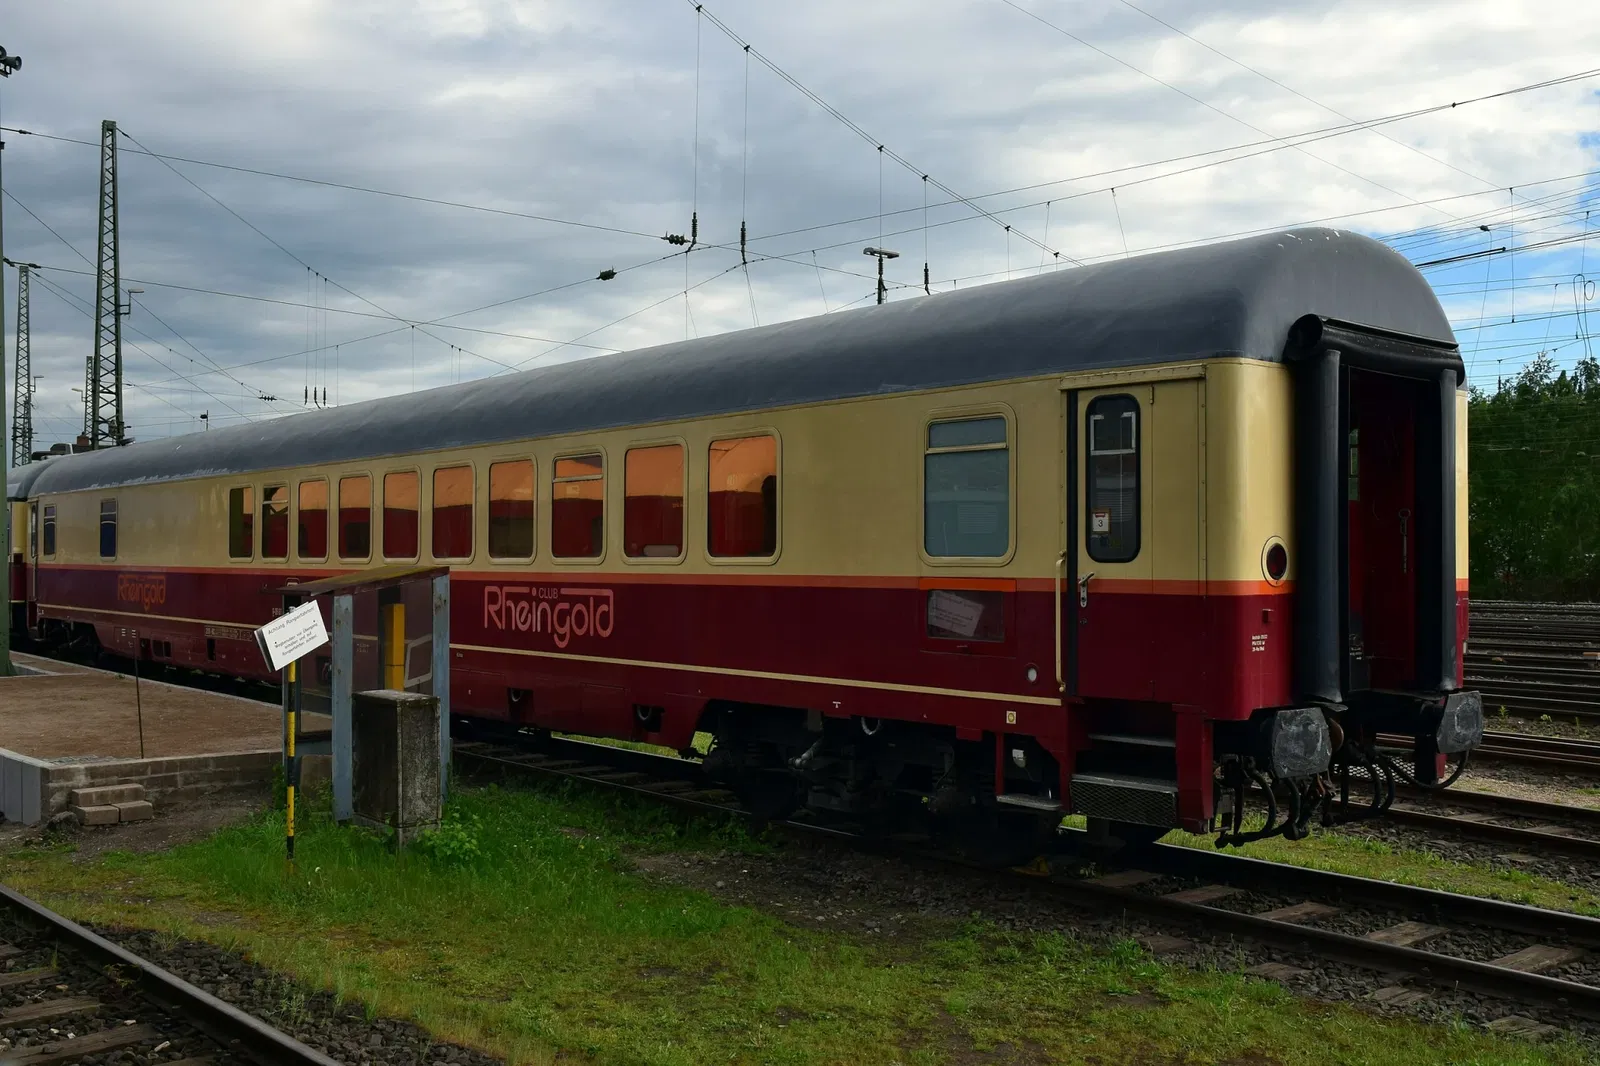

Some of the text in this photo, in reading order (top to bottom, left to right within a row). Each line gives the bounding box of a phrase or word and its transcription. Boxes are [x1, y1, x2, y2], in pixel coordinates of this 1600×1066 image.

[1098, 519, 1104, 527] 3
[118, 574, 166, 612] Rheingold
[538, 587, 559, 599] CLUB
[484, 585, 614, 648] Rheingold
[268, 623, 286, 635] Achtung
